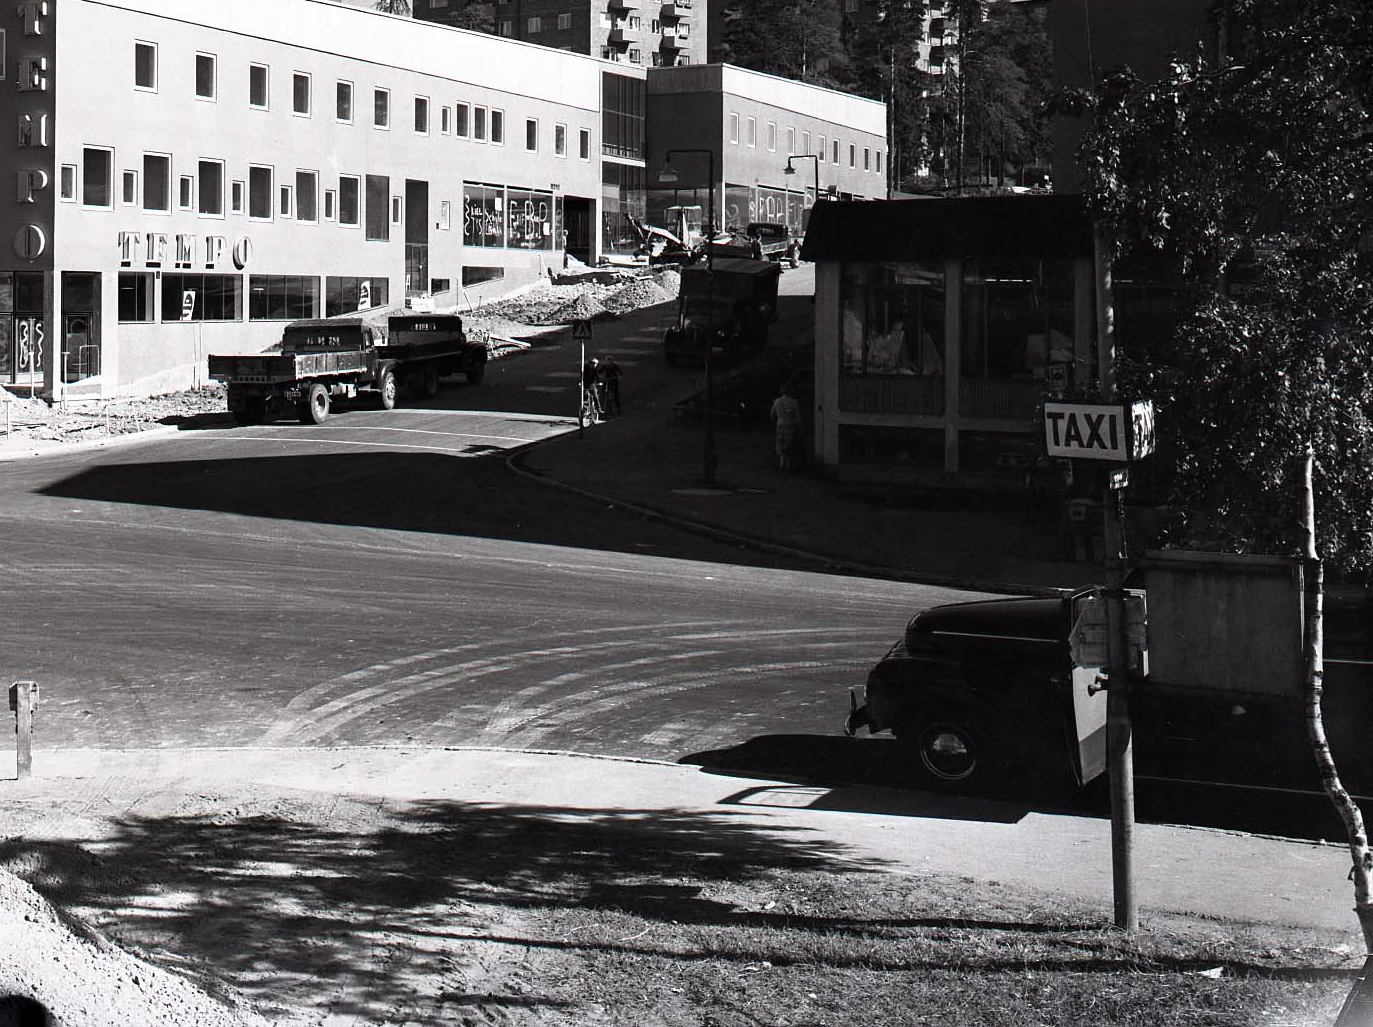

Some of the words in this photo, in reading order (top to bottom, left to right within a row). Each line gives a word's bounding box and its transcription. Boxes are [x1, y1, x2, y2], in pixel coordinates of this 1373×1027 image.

[15, 0, 49, 263] TEMPO
[117, 231, 253, 270] TEMPO
[1046, 411, 1119, 450] TAXI
